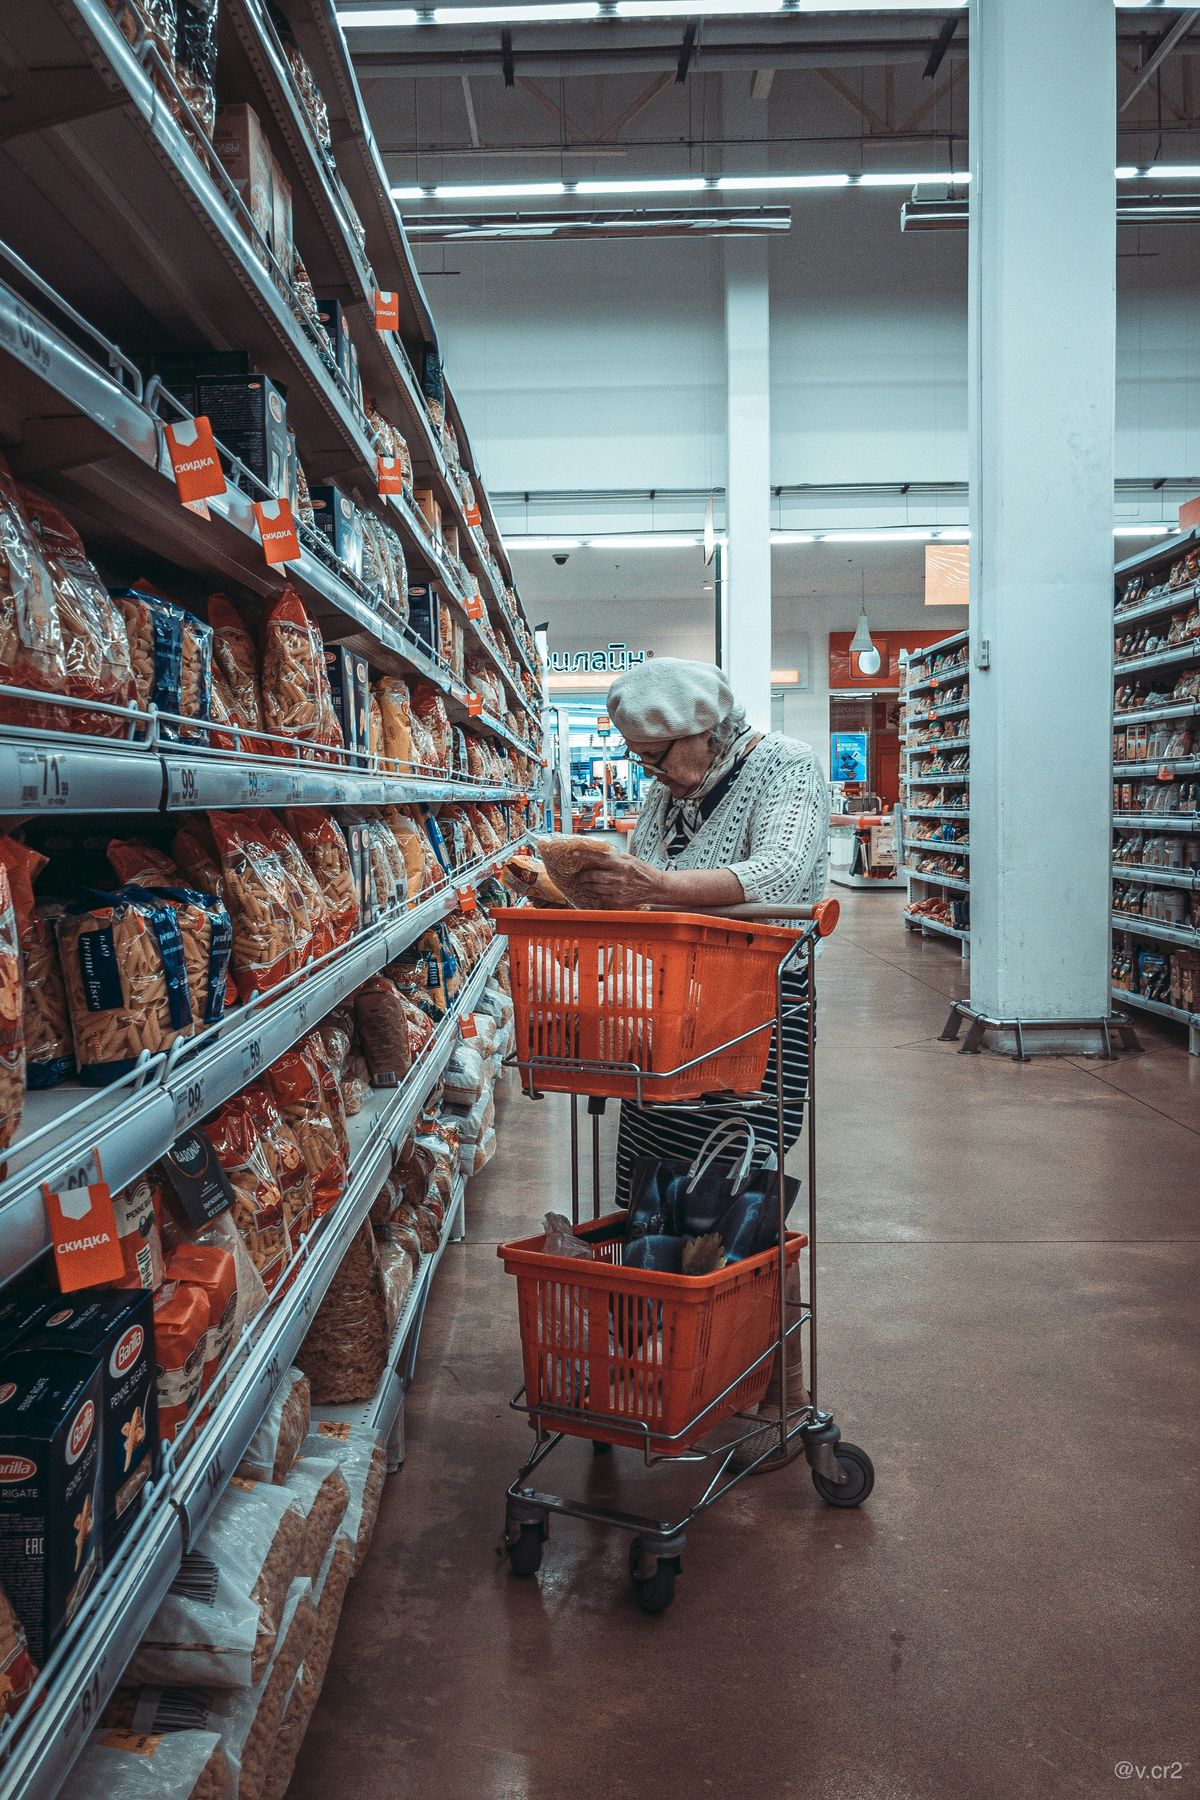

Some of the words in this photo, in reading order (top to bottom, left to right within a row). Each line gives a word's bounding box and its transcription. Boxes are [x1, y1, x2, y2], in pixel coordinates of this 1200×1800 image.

[174, 456, 215, 474] СКИДКА
[262, 529, 292, 541] СКИДКА
[546, 643, 645, 673] илайн
[80, 937, 95, 977] penne
[88, 981, 102, 1010] lisce
[57, 1232, 111, 1254] СКИДКА
[0, 1462, 31, 1474] arilla
[2, 1488, 39, 1498] RIGATE
